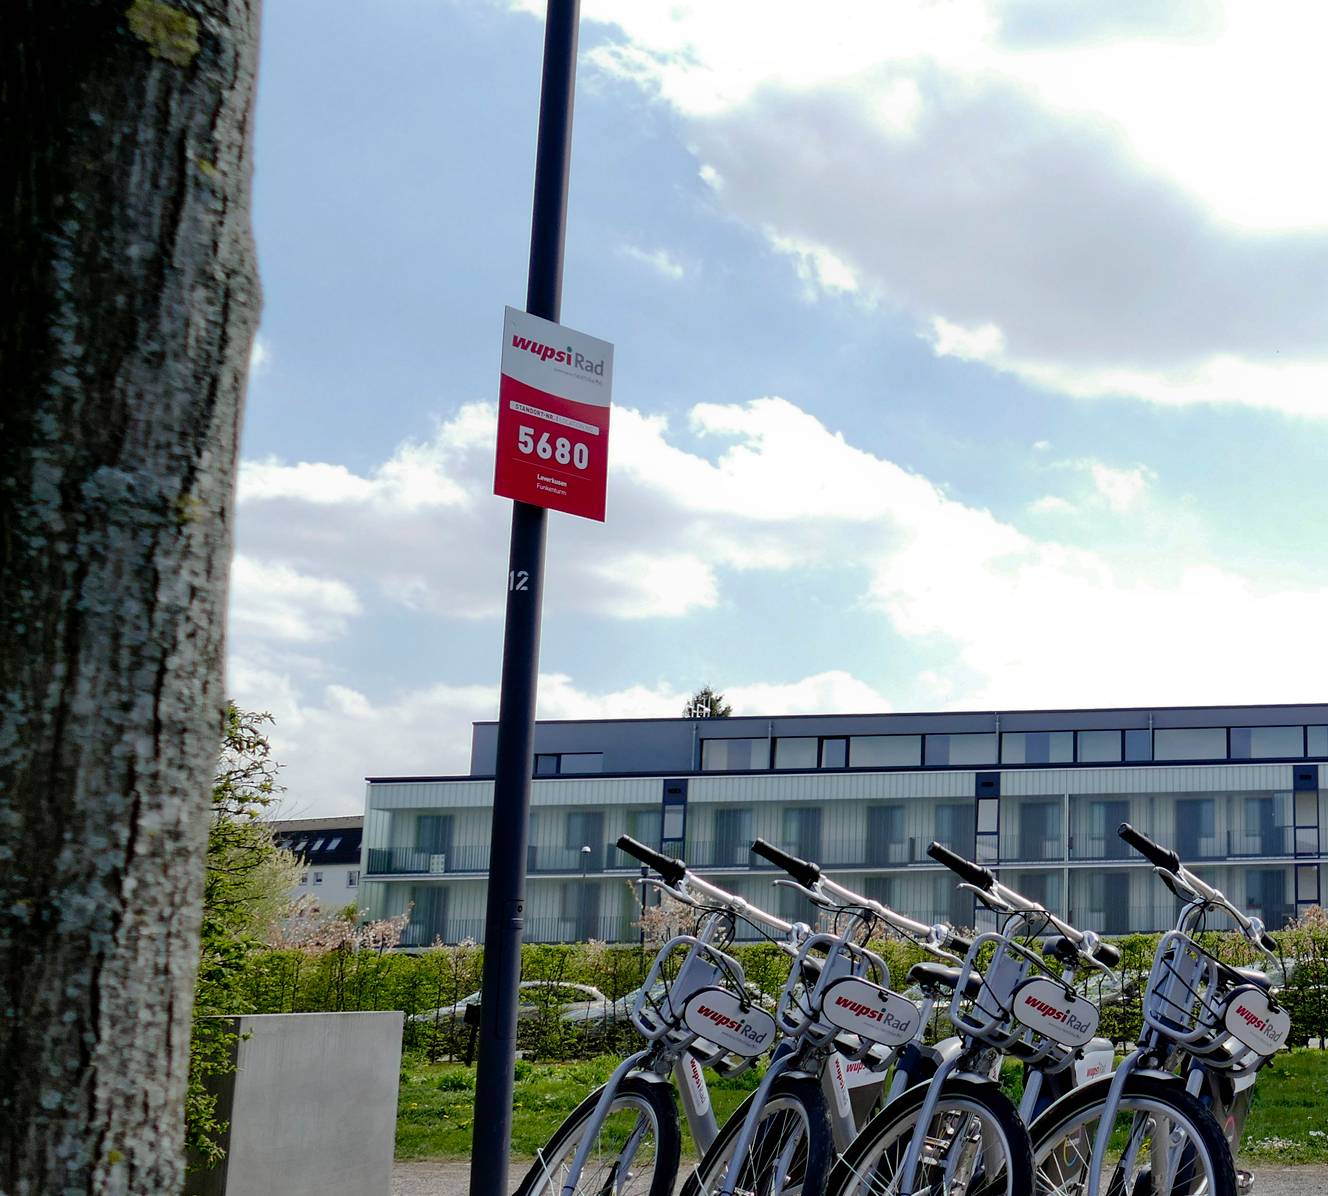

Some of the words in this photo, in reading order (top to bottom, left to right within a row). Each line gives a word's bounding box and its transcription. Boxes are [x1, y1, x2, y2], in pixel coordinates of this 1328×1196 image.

[512, 335, 573, 366] wupsi
[574, 352, 604, 376] Rad
[518, 425, 589, 470] 5680
[509, 570, 529, 591] 12
[697, 1005, 746, 1033] wupsi
[740, 1024, 767, 1044] Rad
[834, 996, 887, 1022] wupsi
[883, 1013, 911, 1033] Rad
[1024, 995, 1071, 1023] wupsi
[1066, 1014, 1091, 1034] Rad
[1235, 1005, 1270, 1032] wupsi
[1263, 1024, 1283, 1042] Rad
